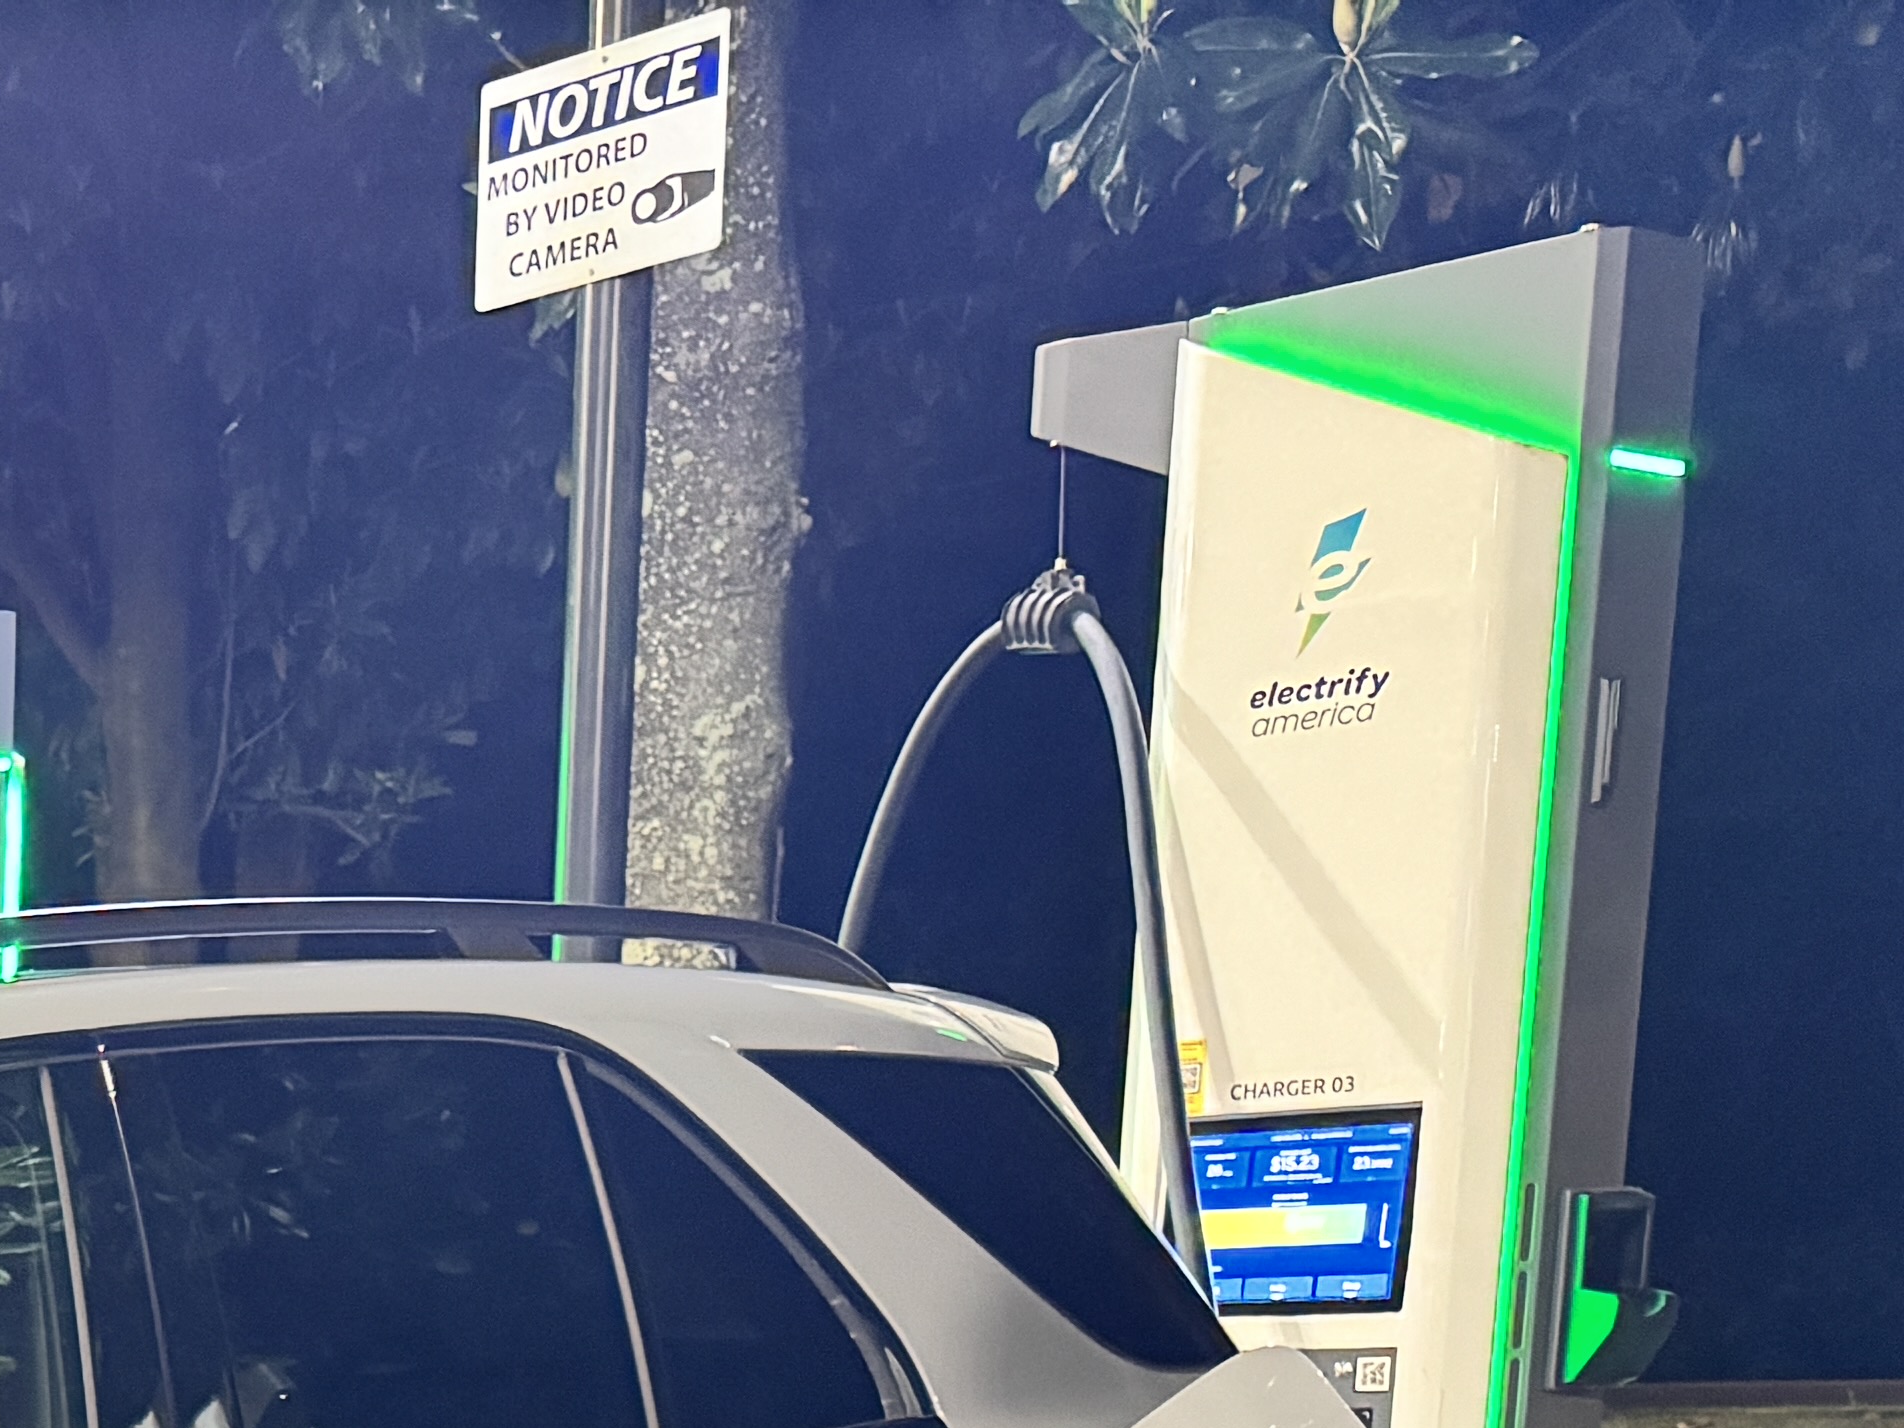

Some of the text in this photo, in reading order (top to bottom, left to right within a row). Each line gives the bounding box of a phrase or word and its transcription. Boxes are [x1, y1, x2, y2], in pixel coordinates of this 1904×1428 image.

[508, 44, 703, 153] NOTICE
[487, 132, 648, 201] MONITORED
[505, 181, 626, 237] BY VIDEO
[508, 227, 618, 278] CAMERA
[1250, 667, 1390, 709] electrify
[1252, 702, 1376, 737] america
[1230, 1075, 1355, 1101] CHARGER 03
